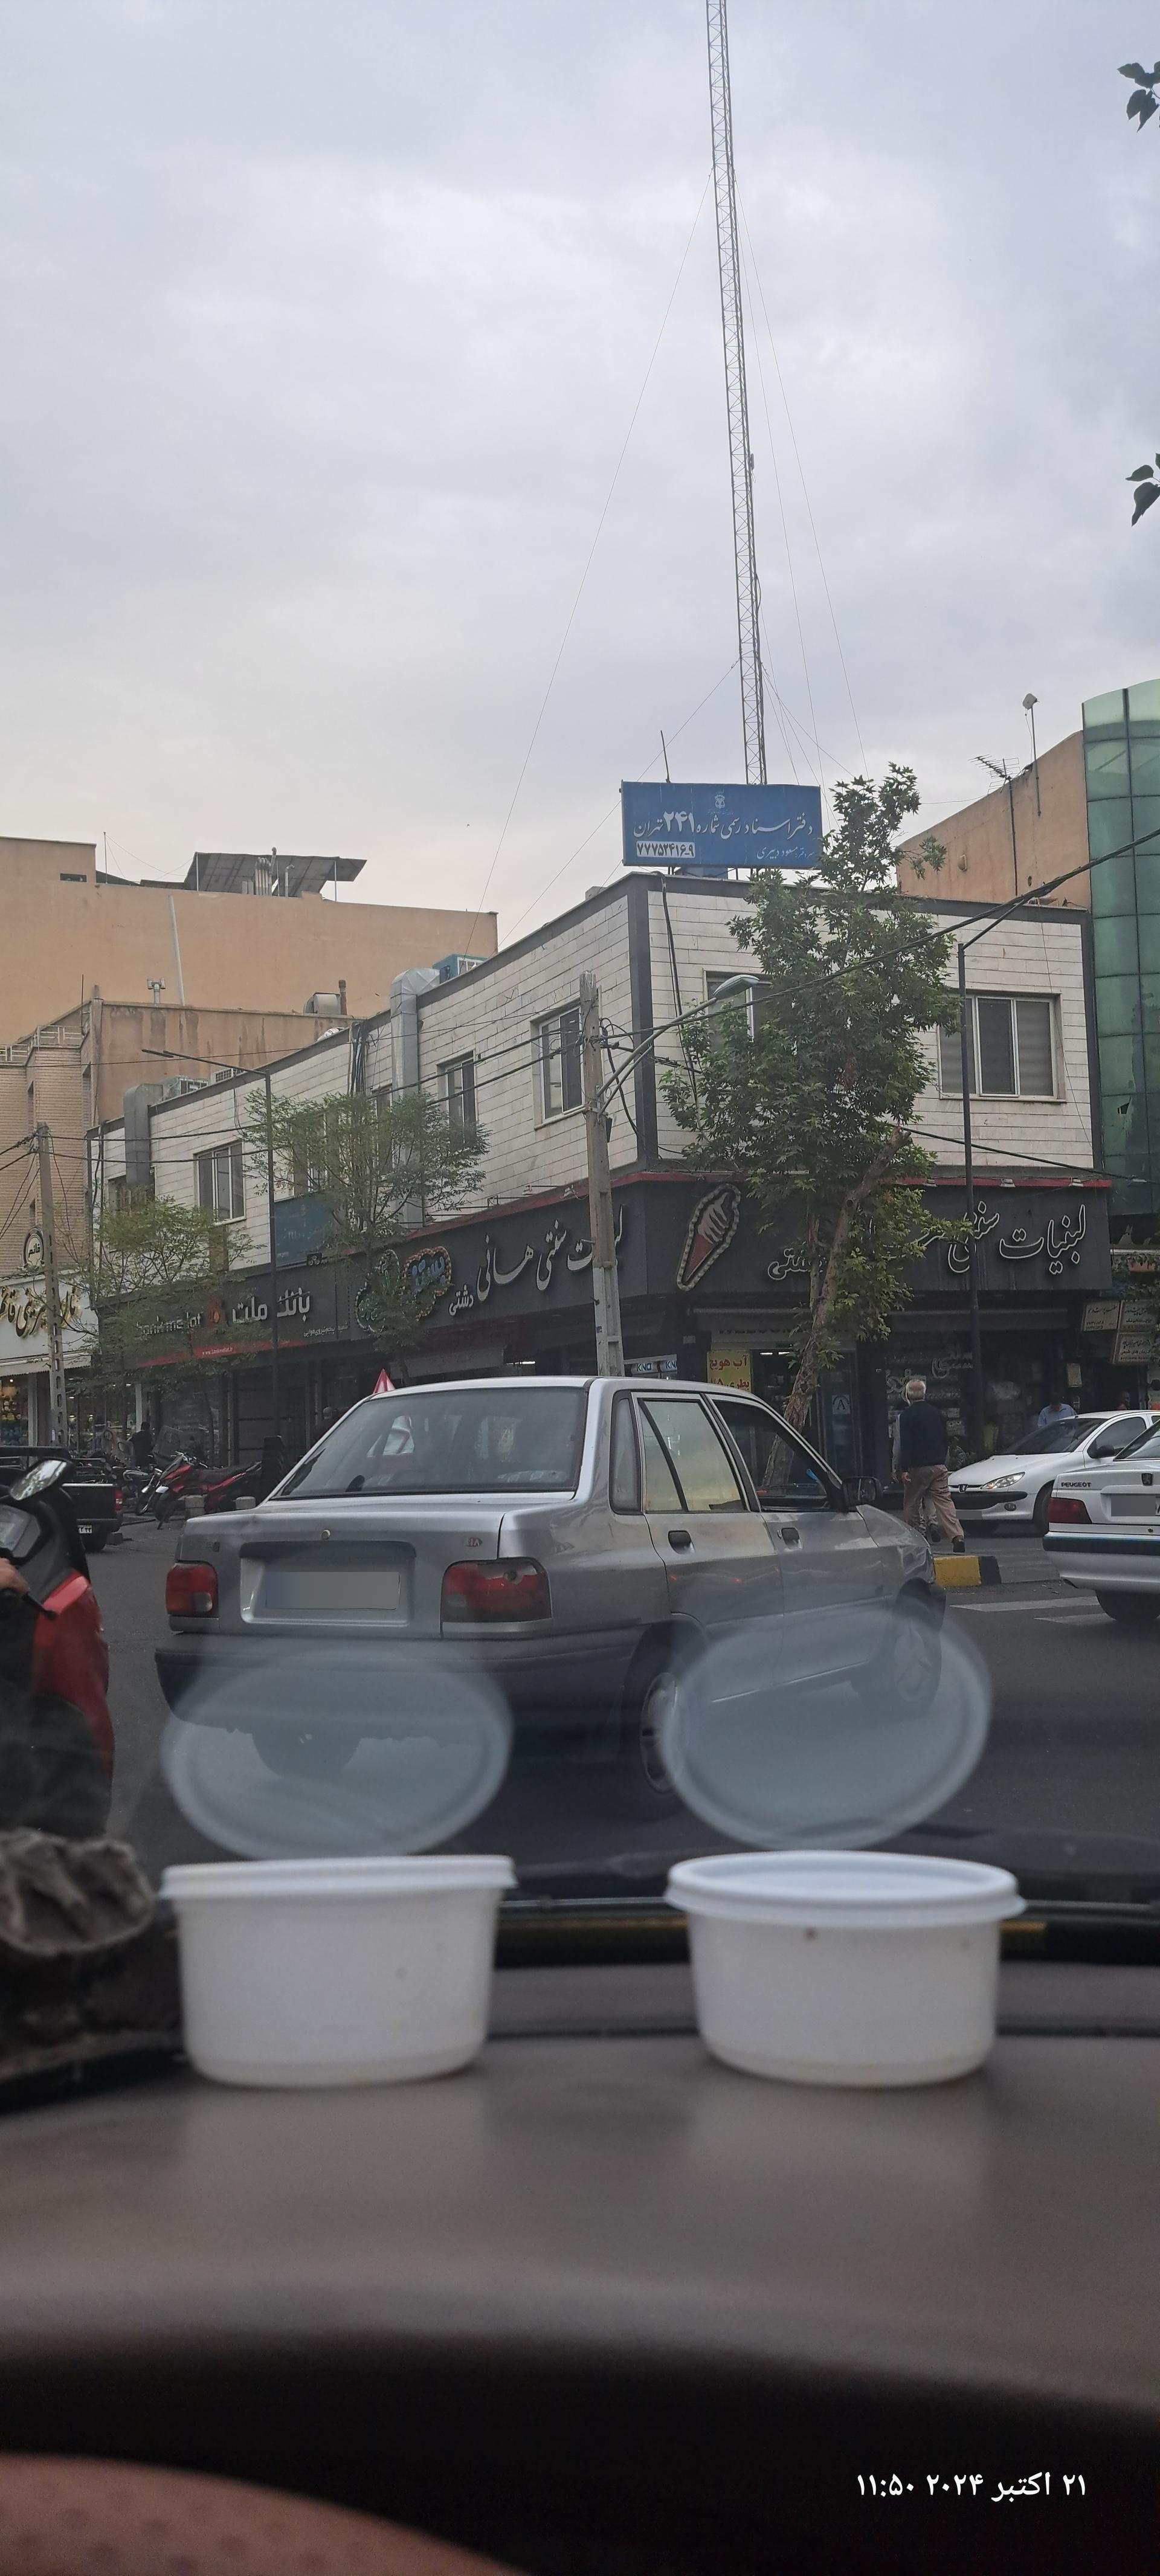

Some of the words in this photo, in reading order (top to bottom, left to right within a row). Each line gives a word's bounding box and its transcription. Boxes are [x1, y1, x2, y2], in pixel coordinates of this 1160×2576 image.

[633, 819, 663, 838] تهران
[663, 811, 695, 833] ۲۴۱
[696, 814, 721, 834] شماره
[720, 817, 741, 840] رسمی
[744, 818, 791, 835] اسناد
[787, 812, 813, 840] دفتر
[28, 1242, 41, 1259] قائم
[999, 1203, 1086, 1275] لبنیات
[477, 1232, 535, 1302] هانی
[536, 1219, 567, 1292] سنتی
[232, 1296, 269, 1324] ملت
[276, 1287, 311, 1322] بانک
[448, 1284, 474, 1316] دشتی
[709, 1358, 730, 1370] هویج
[733, 1354, 749, 1370] آب
